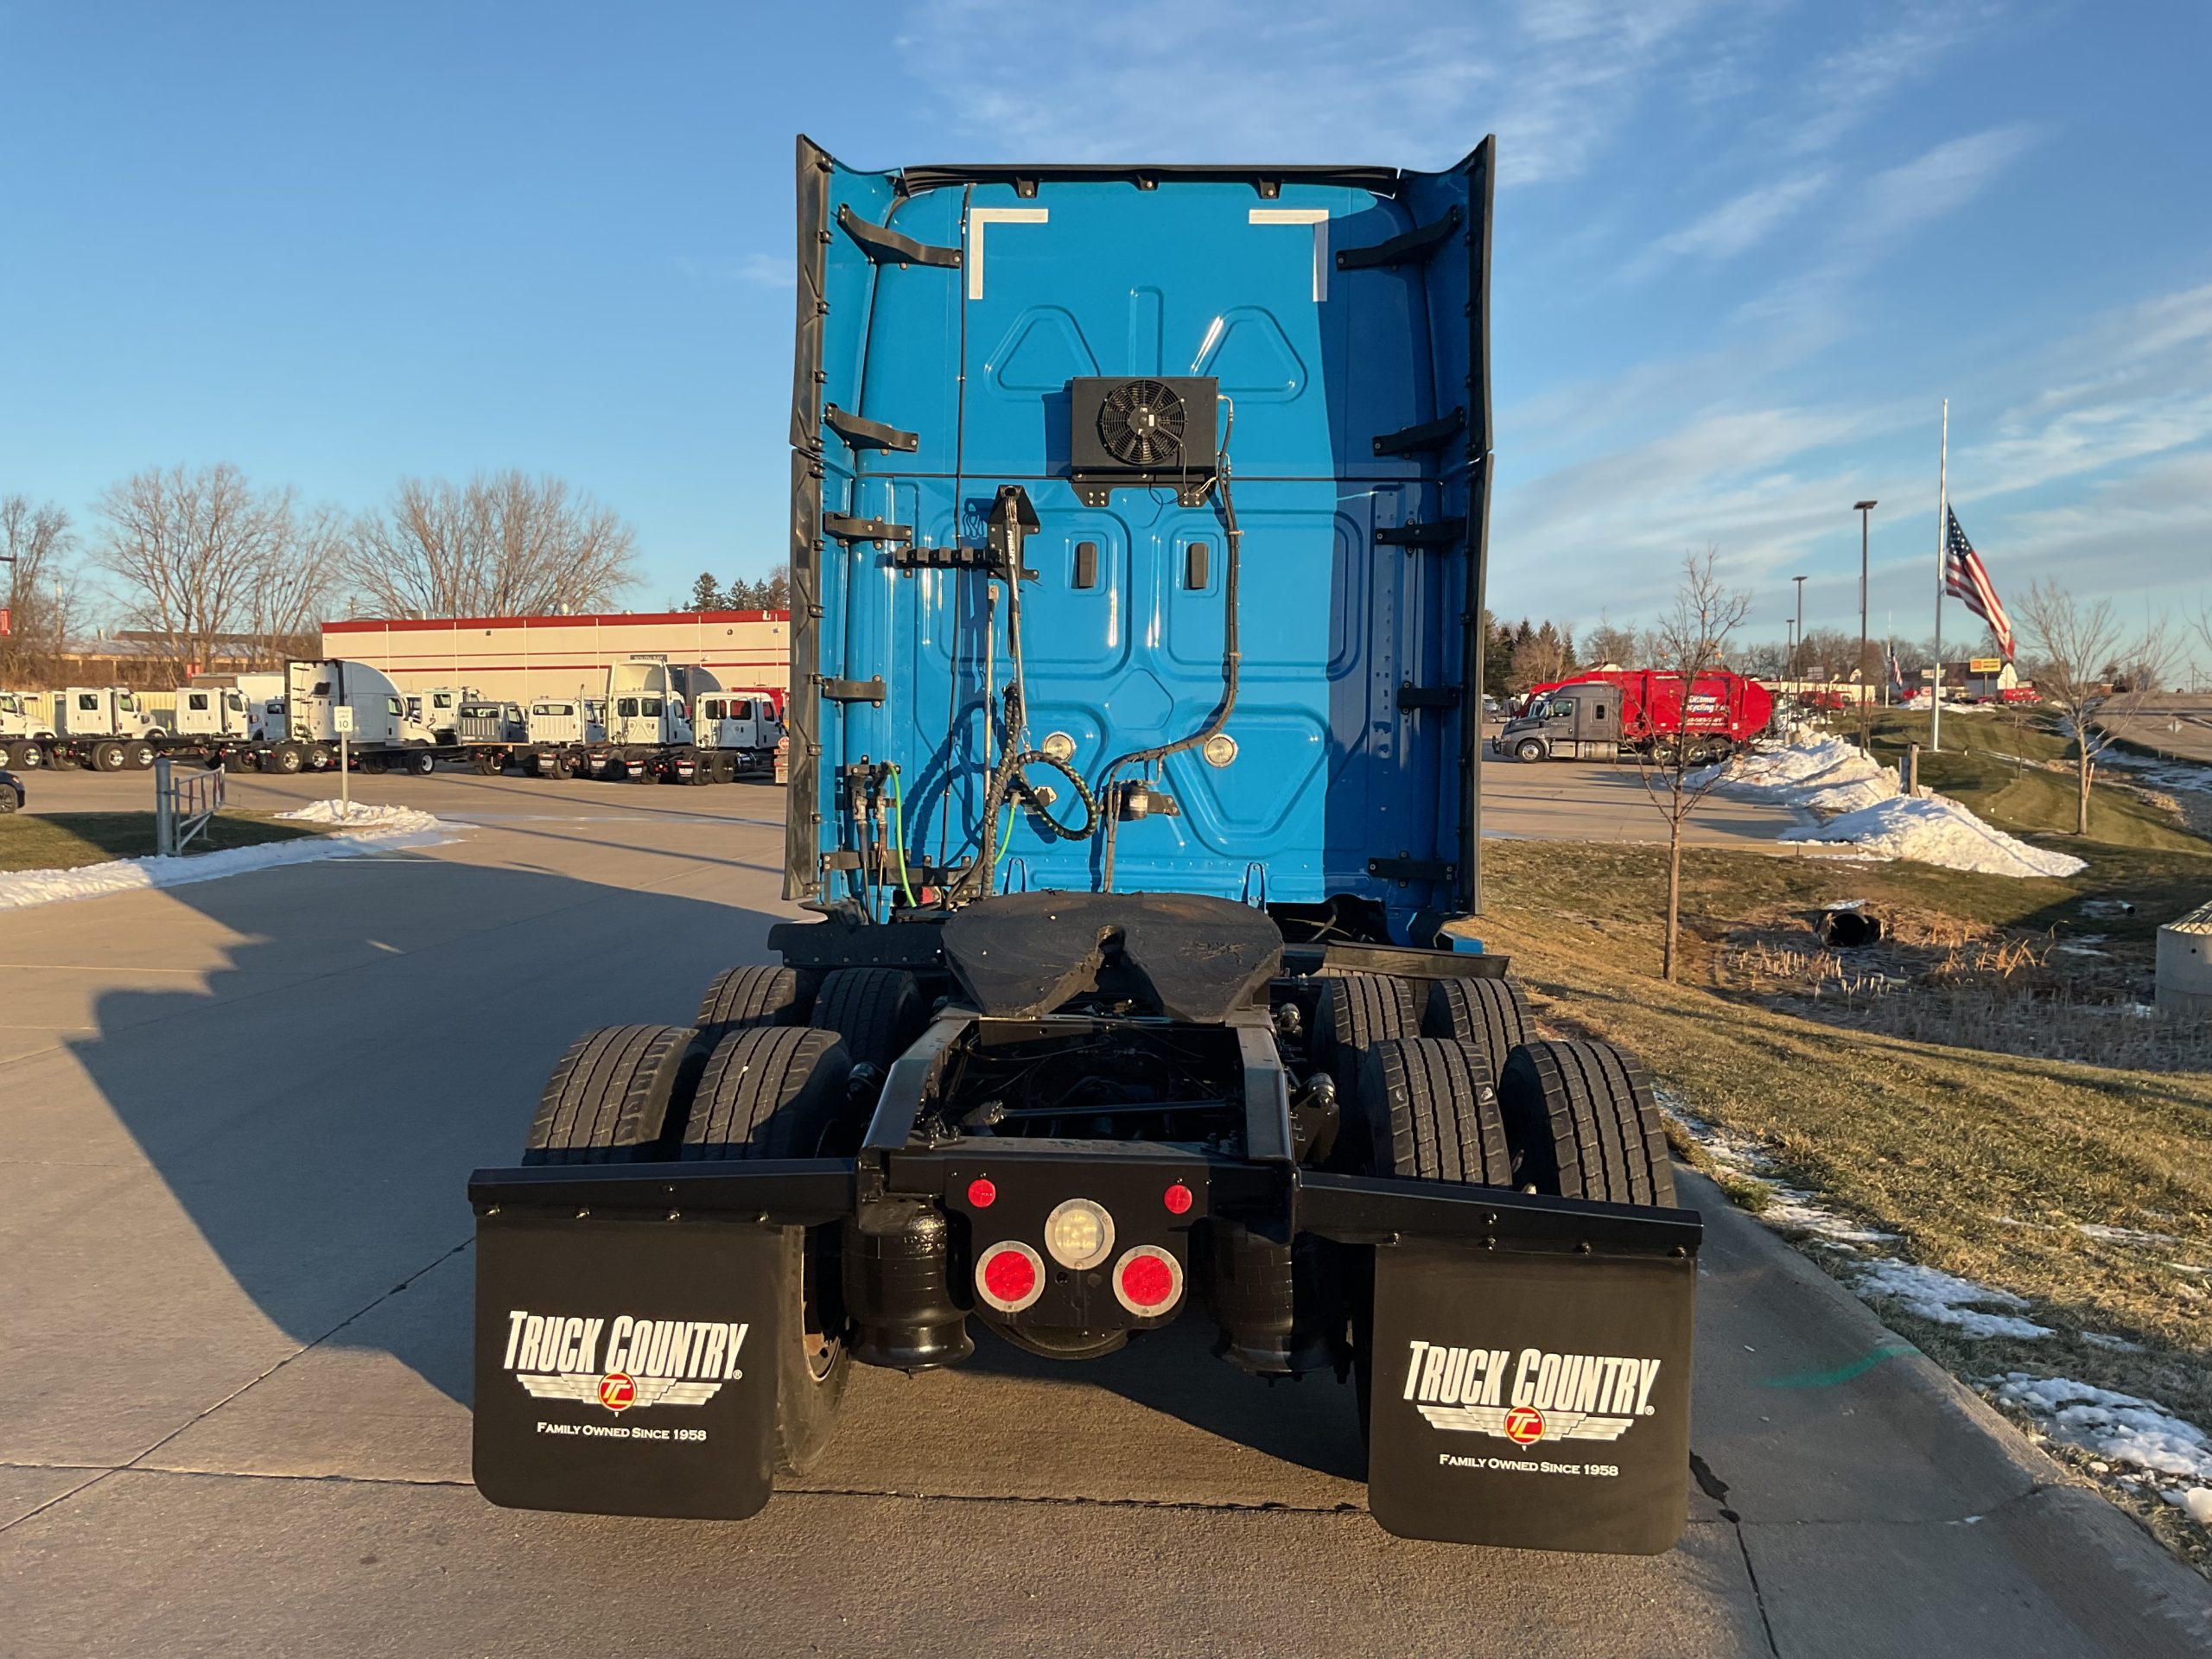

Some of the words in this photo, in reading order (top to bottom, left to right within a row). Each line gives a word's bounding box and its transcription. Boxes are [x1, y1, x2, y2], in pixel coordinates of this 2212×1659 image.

[339, 720, 349, 728] 10
[503, 1310, 605, 1373] TRUCK
[604, 1314, 749, 1380] COUNTRY
[1402, 1340, 1510, 1406] TRUCK
[1510, 1348, 1662, 1416] COUNTRY
[537, 1421, 581, 1436] FAMILY
[582, 1424, 630, 1438] OWNED
[632, 1427, 670, 1440] SINCE
[672, 1429, 707, 1441] 1958
[1439, 1453, 1487, 1469] FAMILY
[1488, 1457, 1538, 1472] OWNED
[1541, 1460, 1580, 1475] SINCE
[1584, 1464, 1619, 1477] 1958
